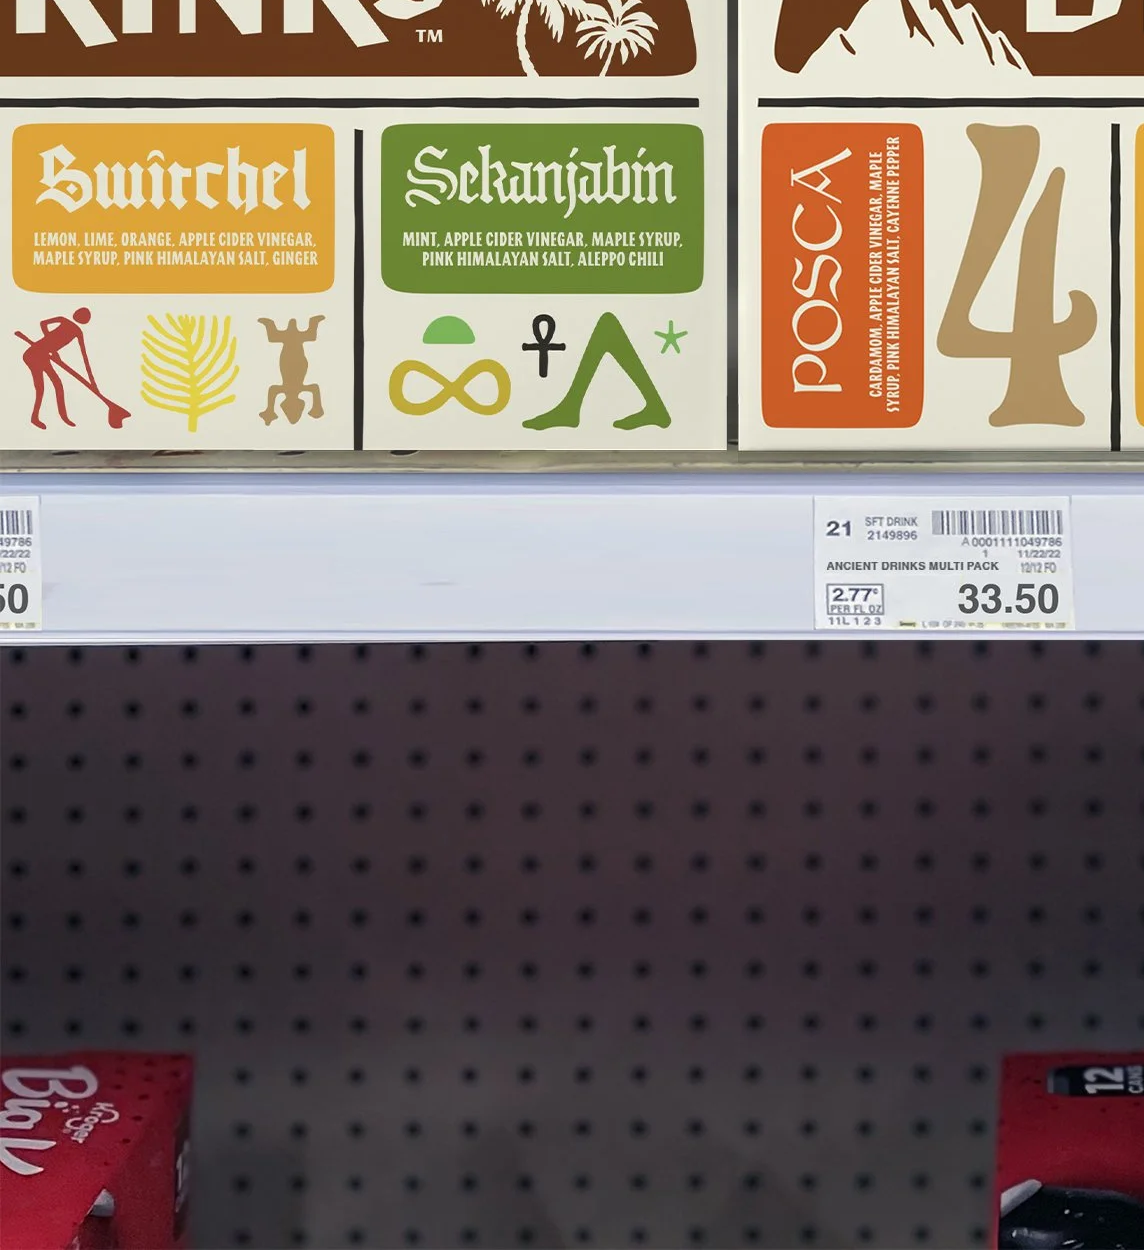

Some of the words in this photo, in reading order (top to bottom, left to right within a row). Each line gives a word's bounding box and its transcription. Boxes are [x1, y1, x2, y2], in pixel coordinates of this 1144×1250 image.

[869, 151, 883, 190] MAPLE
[886, 136, 900, 177] PEPPER
[869, 193, 883, 248] VINEGAR,
[886, 180, 900, 233] CAYENNE
[34, 232, 80, 247] LEMON,
[84, 232, 117, 247] LIME,
[121, 232, 175, 247] ORANGE,
[179, 232, 215, 247] APPLE
[219, 232, 254, 247] CIDER
[258, 232, 316, 247] VINEGAR,
[403, 232, 439, 247] MINT,
[444, 232, 482, 247] APPLE
[486, 232, 523, 247] CIDER
[527, 232, 588, 247] VINEGAR,
[592, 232, 635, 247] MAPLE
[639, 232, 683, 247] SYRUP,
[886, 236, 900, 264] SALT,
[33, 251, 74, 266] MAPLE
[78, 251, 120, 266] SYRUP,
[124, 251, 153, 266] PINK
[157, 251, 235, 266] HIMALAYAN
[239, 251, 269, 267] SALT,
[273, 251, 318, 266] GINGER
[422, 251, 453, 266] PINK
[457, 251, 538, 266] HIMALAYAN
[542, 251, 574, 268] SALT,
[578, 251, 625, 266] ALEPPO
[629, 251, 664, 266] CHILI
[791, 147, 853, 393] POSCA
[869, 251, 883, 284] CIDER
[937, 123, 1098, 428] 4
[869, 287, 883, 321] APPLE
[886, 268, 900, 340] HIMALAYAN
[869, 325, 883, 398] CARDAMOM,
[886, 343, 900, 370] PINK
[886, 373, 900, 413] SYRUP,
[826, 520, 851, 537] 21
[865, 517, 884, 527] SFT
[887, 517, 918, 527] DRINK
[867, 530, 918, 541] 2149896
[826, 561, 878, 571] ANCIENT
[881, 561, 926, 571] DRINKS
[929, 561, 964, 571] MULTI
[967, 561, 1000, 571] PACK
[1017, 550, 1061, 559] 11/22/22
[831, 605, 850, 613] PER
[854, 605, 866, 613] FL
[869, 605, 881, 614] OZ
[957, 583, 1059, 615] 33.50
[1084, 1066, 1124, 1095] 12
[1128, 1064, 1144, 1094] CANS
